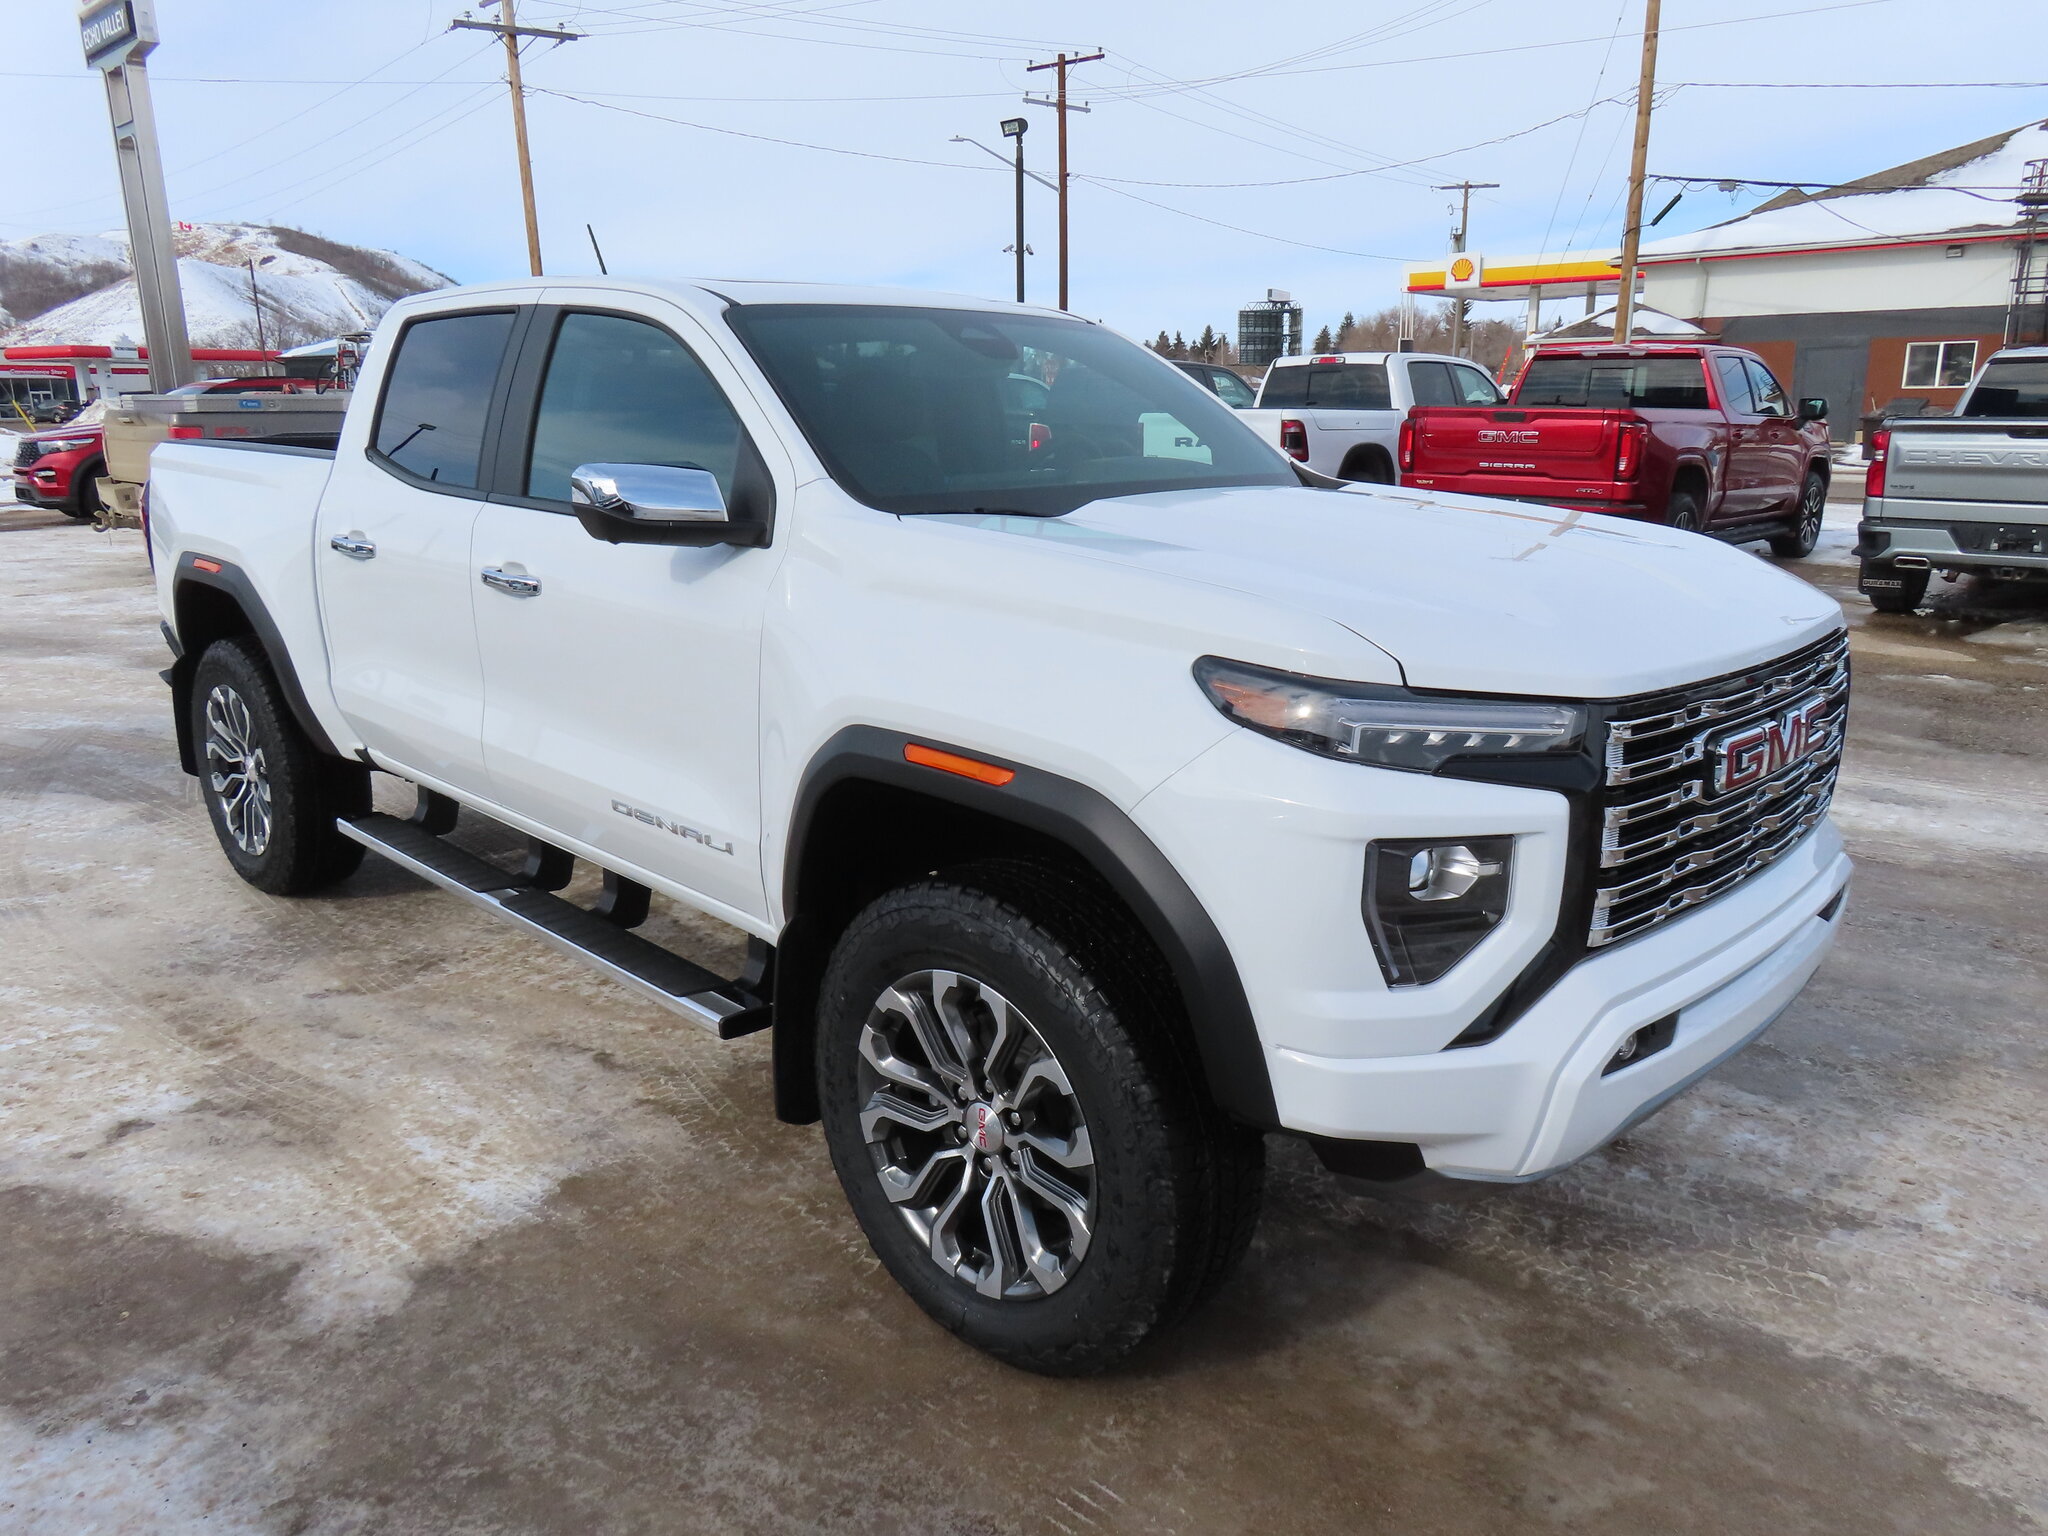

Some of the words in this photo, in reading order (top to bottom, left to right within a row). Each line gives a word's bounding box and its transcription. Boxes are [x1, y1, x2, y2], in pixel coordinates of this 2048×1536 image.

[82, 23, 101, 50] ECHO
[99, 8, 125, 40] VALLEY
[1478, 430, 1539, 444] GMC
[1904, 450, 2048, 466] CHEVR
[1862, 578, 1902, 588] DURAMAX
[1720, 696, 1827, 793] GMC
[611, 799, 734, 856] DENALI
[978, 1107, 987, 1148] GMC
